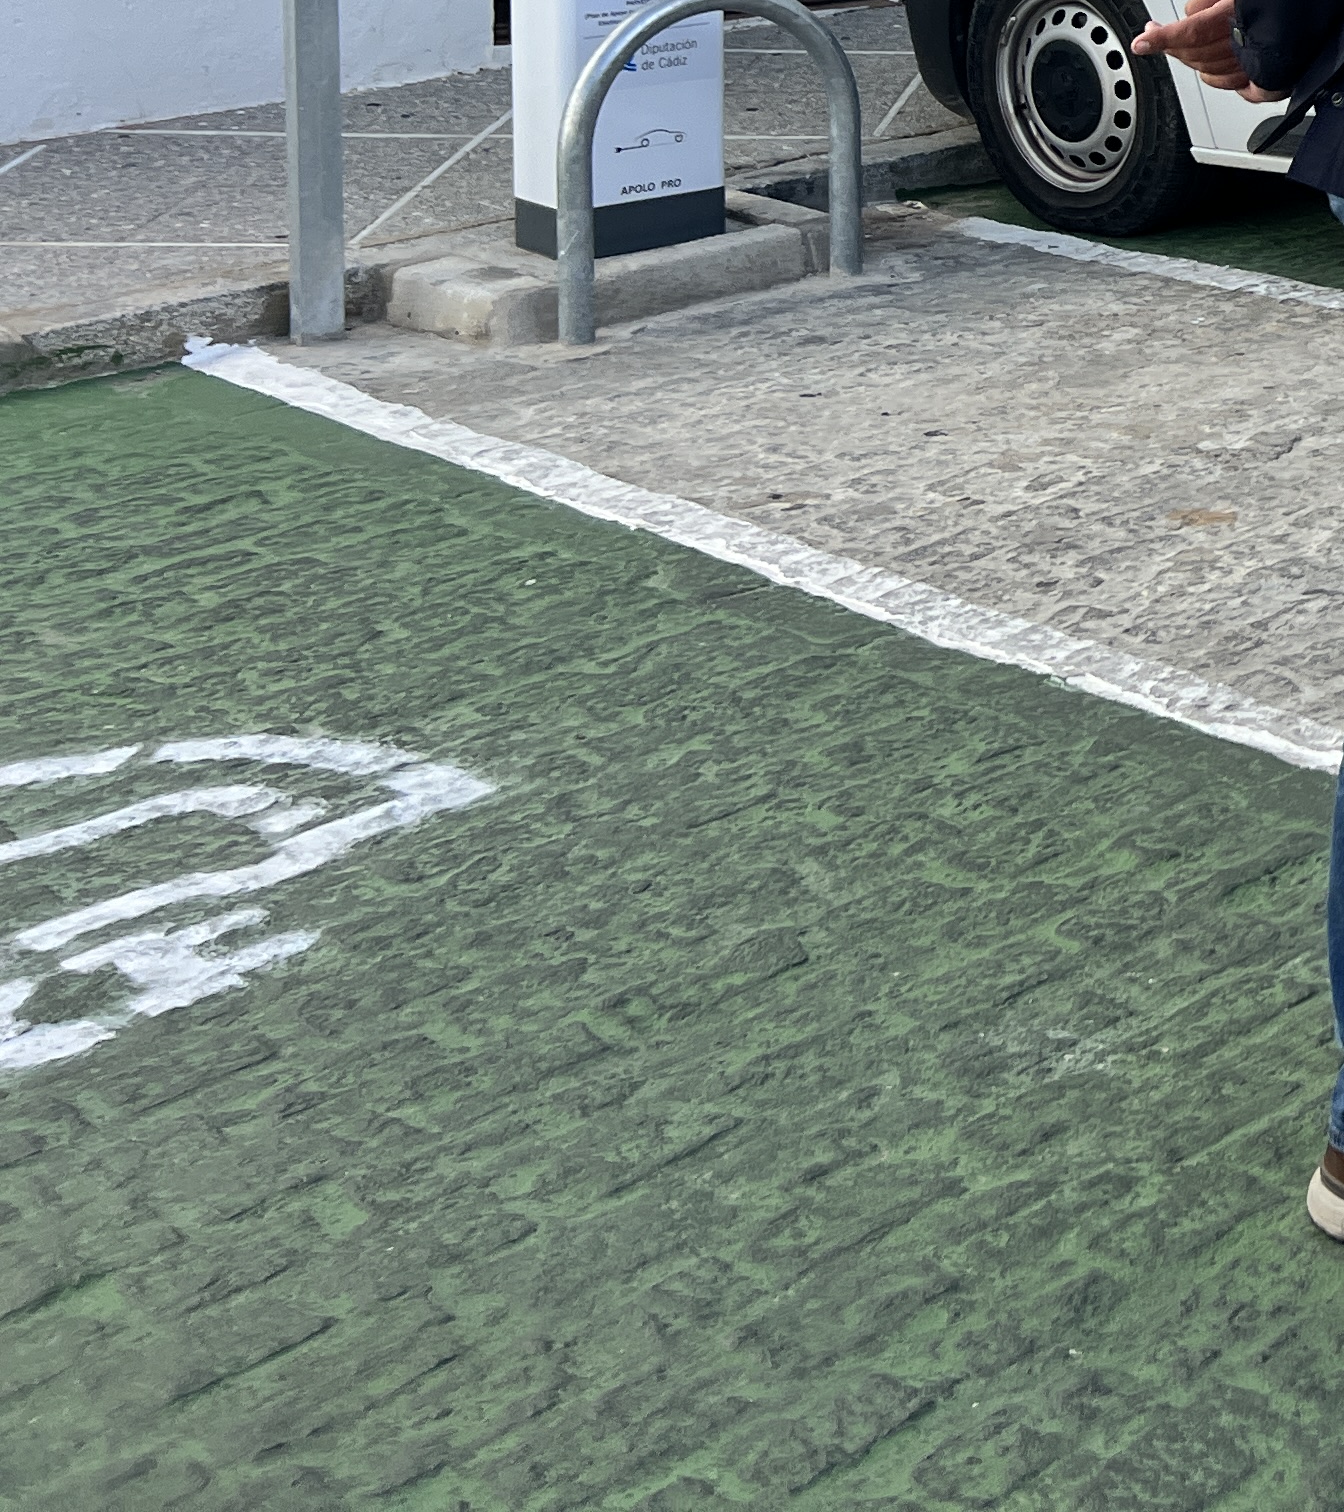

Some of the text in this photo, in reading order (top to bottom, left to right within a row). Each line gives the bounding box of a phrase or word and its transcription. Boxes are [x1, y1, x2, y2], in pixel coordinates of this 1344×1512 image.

[641, 38, 697, 57] Diputación
[641, 54, 689, 71] de Cádiz
[620, 178, 682, 196] APOLO PRO
